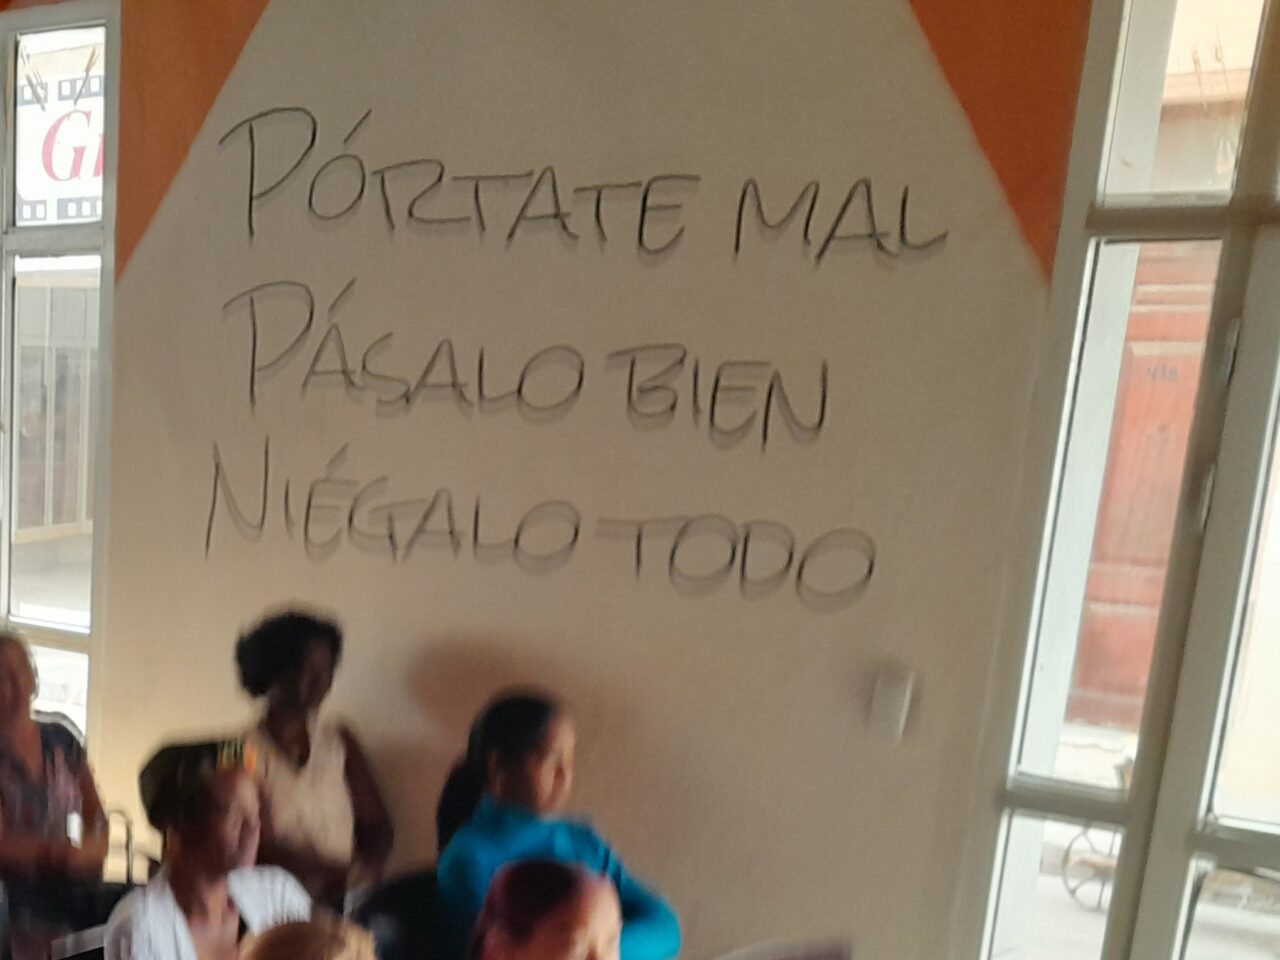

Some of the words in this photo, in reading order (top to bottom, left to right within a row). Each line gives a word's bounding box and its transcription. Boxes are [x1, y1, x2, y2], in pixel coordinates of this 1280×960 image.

[219, 106, 700, 257] PÓRTATE
[732, 176, 949, 266] MAL
[222, 276, 586, 418] PÁSALO
[605, 342, 830, 453] BIEN
[204, 432, 581, 567] NIÉGALO
[595, 512, 877, 610] TODO
